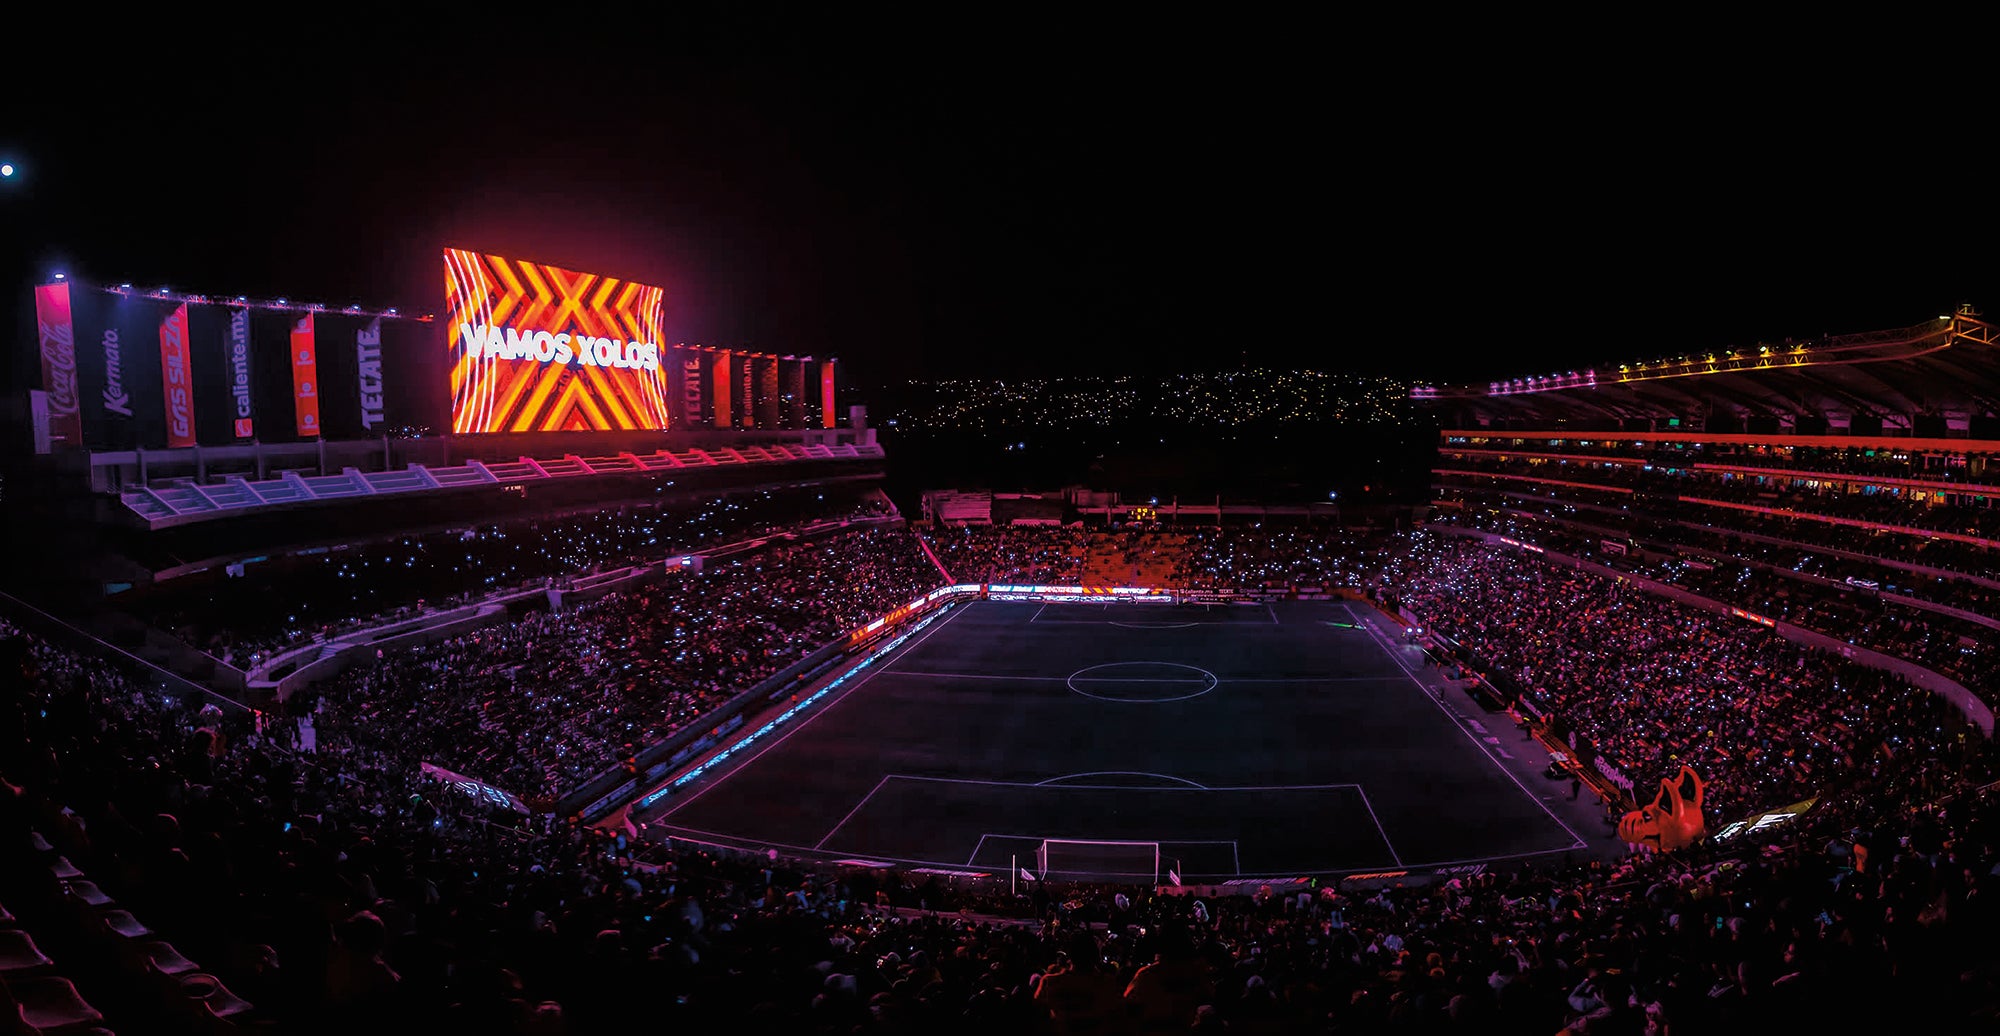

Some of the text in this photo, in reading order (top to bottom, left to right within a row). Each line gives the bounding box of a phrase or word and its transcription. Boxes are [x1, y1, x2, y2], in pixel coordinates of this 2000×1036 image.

[102, 328, 132, 416] Kermato
[231, 309, 251, 417] caliente.mx
[357, 325, 385, 431] TECATE
[460, 323, 660, 371] VAMOS XOLOS
[684, 357, 701, 426] TECATE
